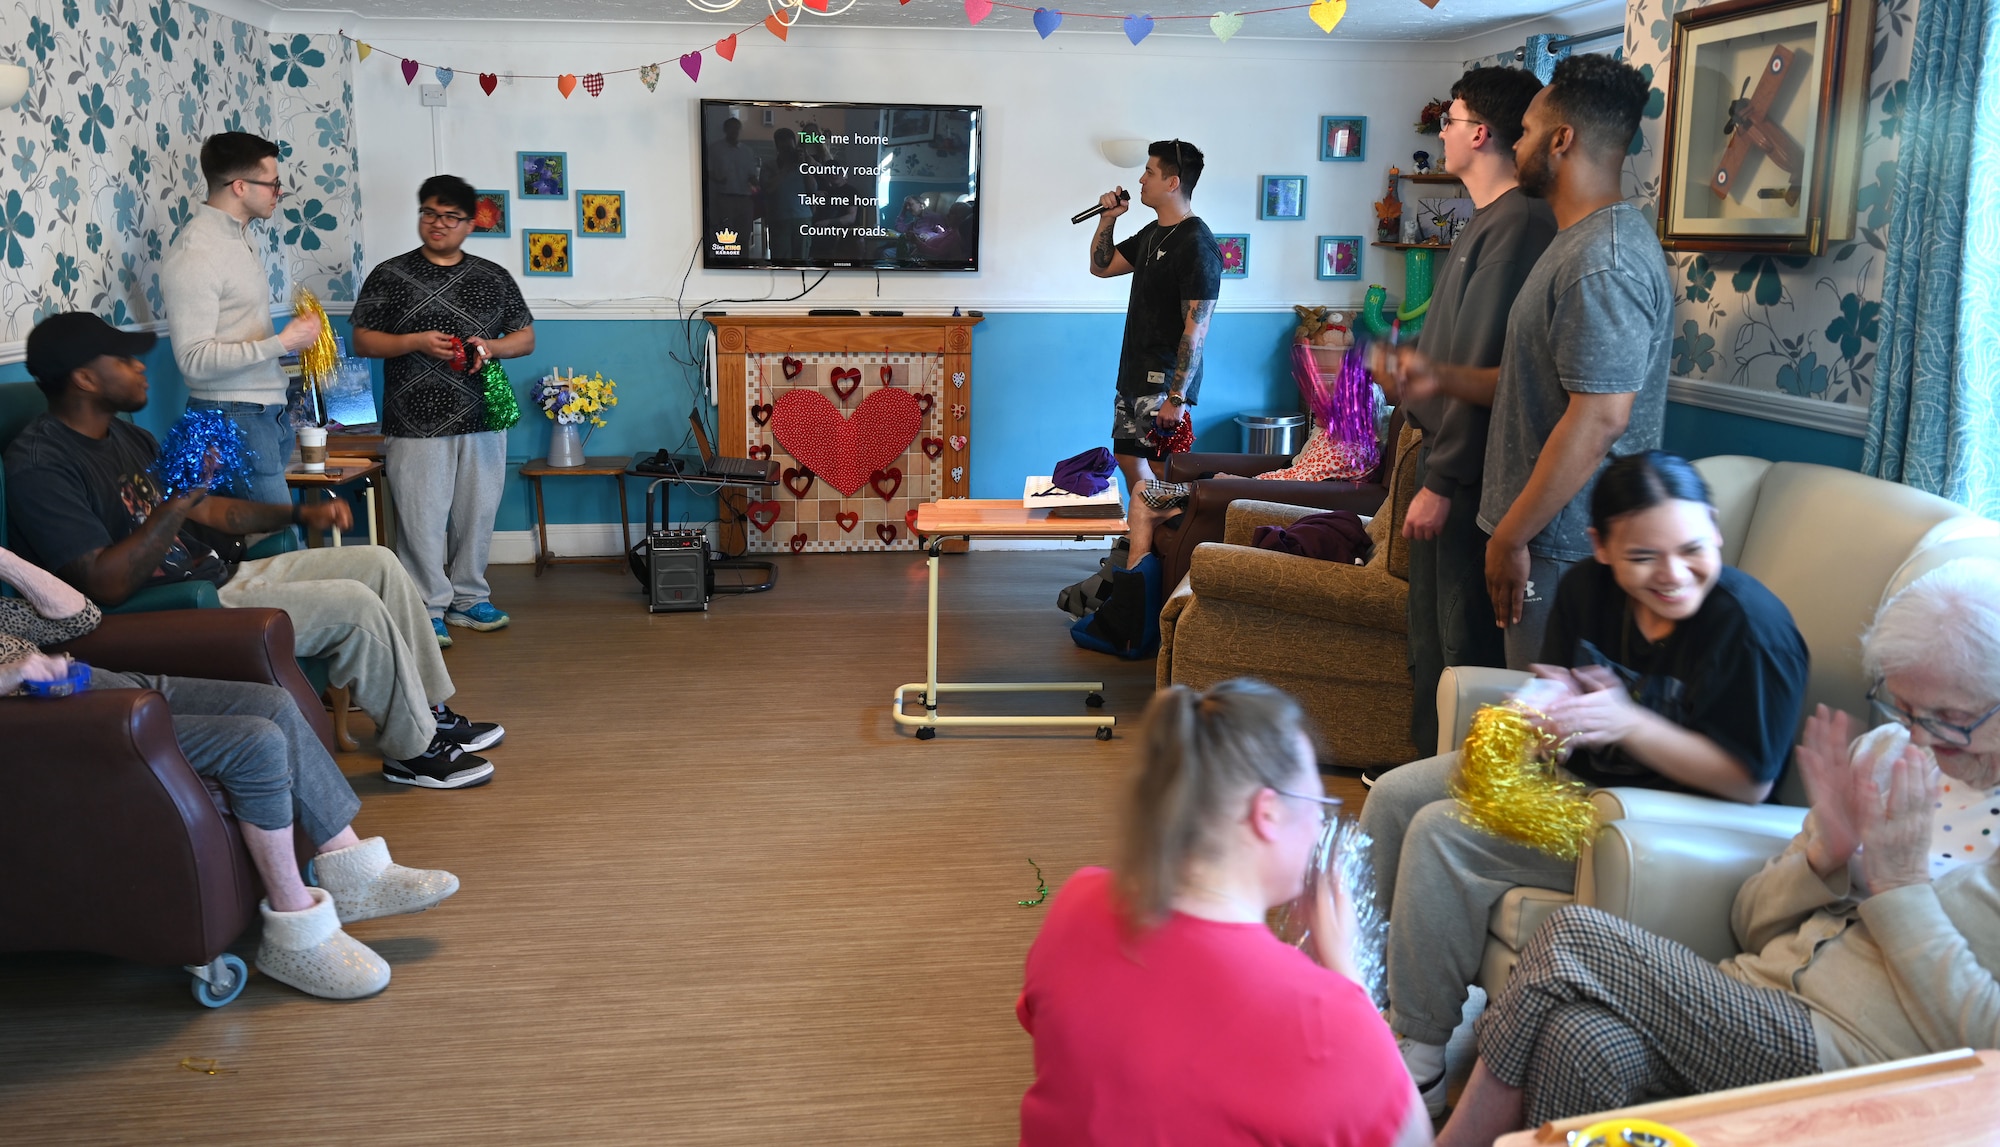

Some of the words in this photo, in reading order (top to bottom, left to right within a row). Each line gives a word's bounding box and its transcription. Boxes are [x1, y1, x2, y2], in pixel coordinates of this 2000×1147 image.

[798, 132, 826, 144] Take
[831, 134, 850, 144] me
[854, 132, 889, 145] home
[799, 163, 849, 178] Country
[797, 193, 826, 205] Take
[831, 196, 850, 206] me
[799, 224, 849, 238] Country
